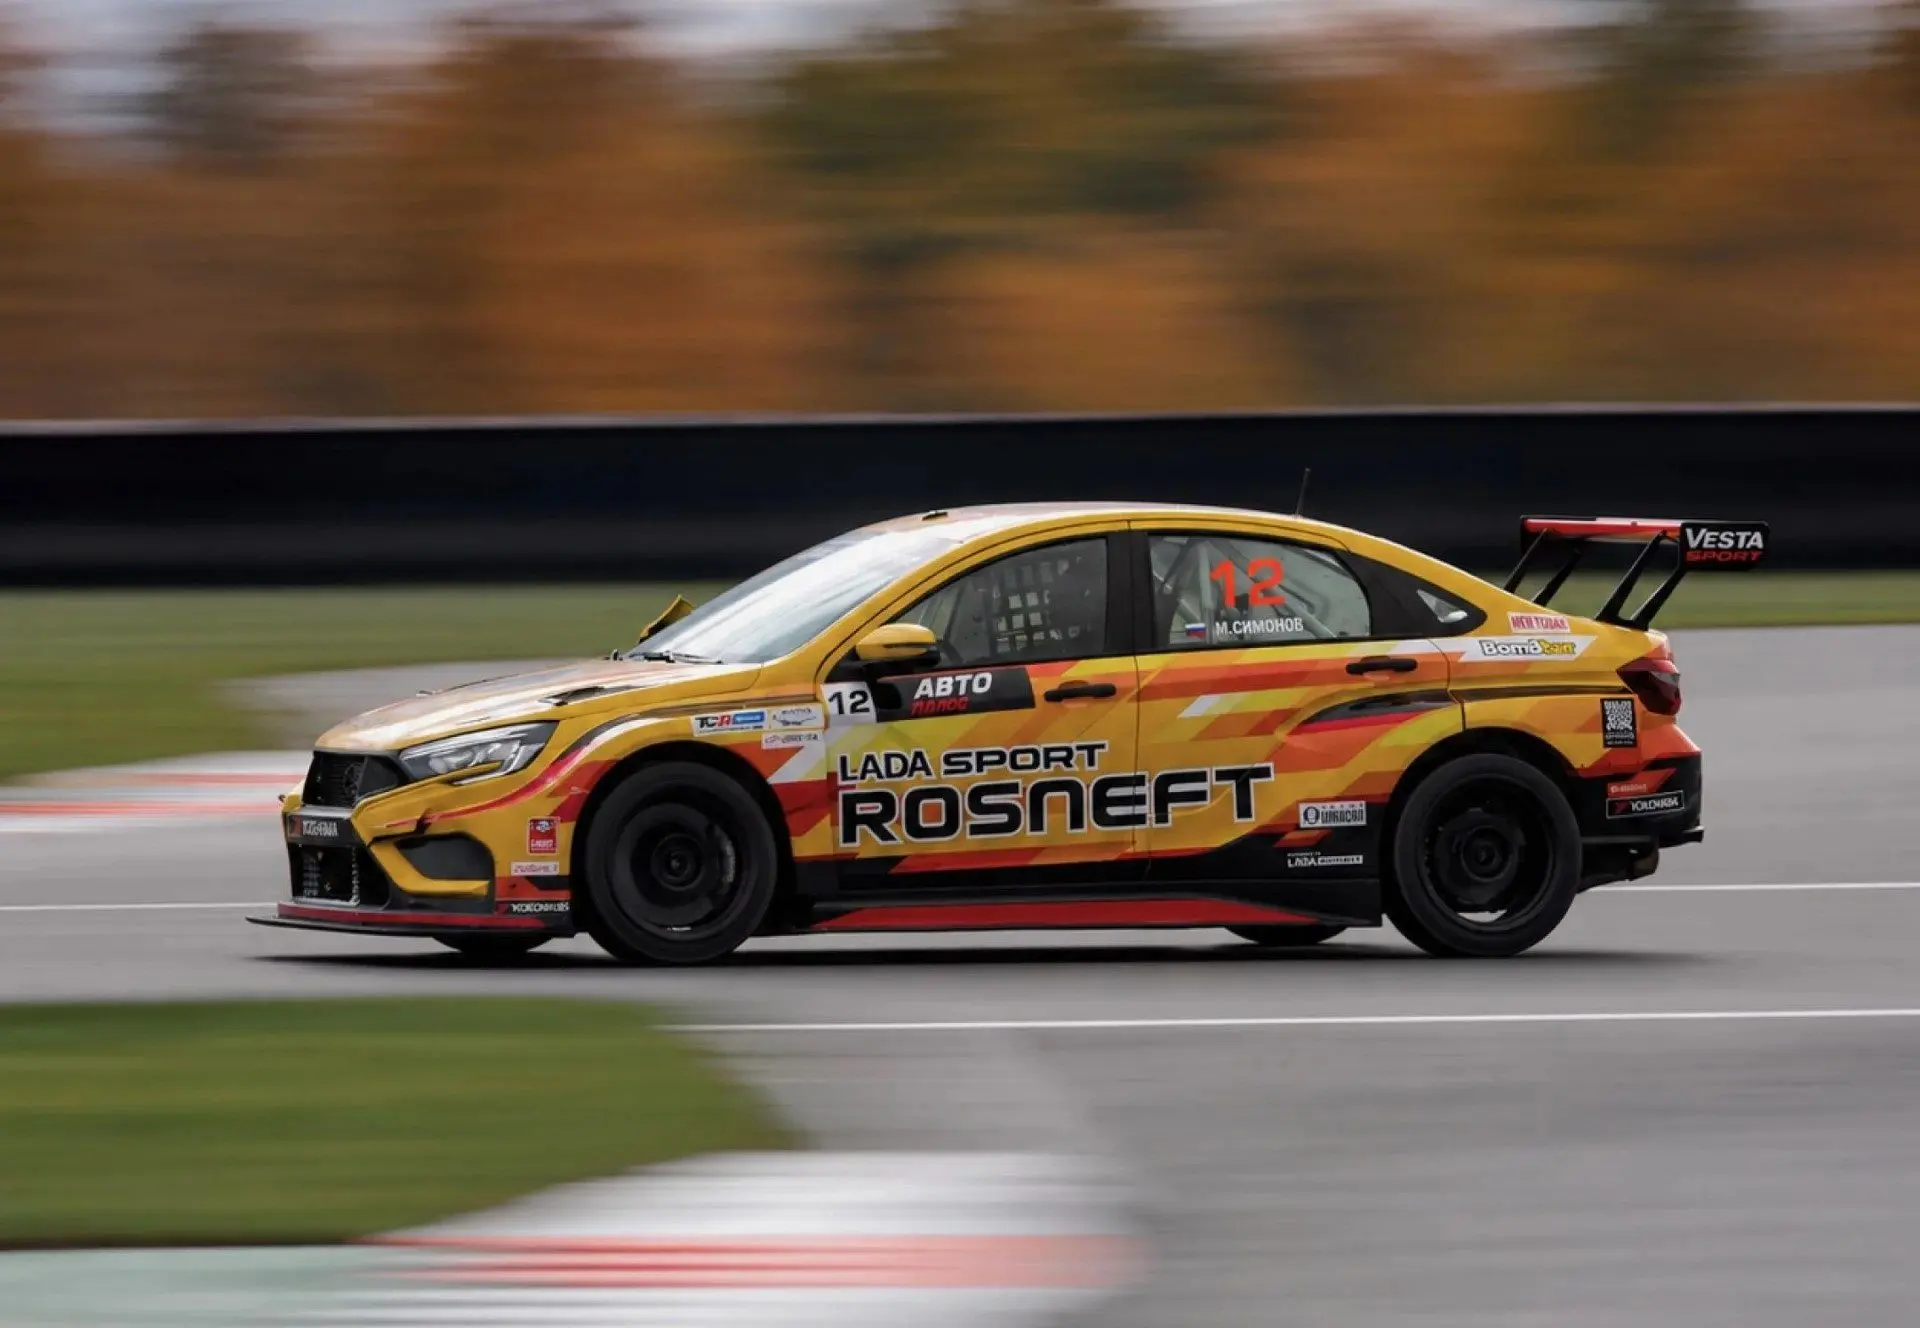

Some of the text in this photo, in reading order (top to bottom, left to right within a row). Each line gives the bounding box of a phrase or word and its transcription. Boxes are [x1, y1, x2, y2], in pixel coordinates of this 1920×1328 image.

[1685, 527, 1764, 550] VESTA
[1686, 551, 1763, 562] SPORT
[1210, 557, 1287, 608] 12
[1215, 617, 1304, 635] М.СИМОНОВ
[913, 672, 993, 699] АВТО
[828, 690, 871, 716] 12
[838, 741, 1109, 784] LADA SPORT
[838, 762, 1276, 849] ROSNEFT
